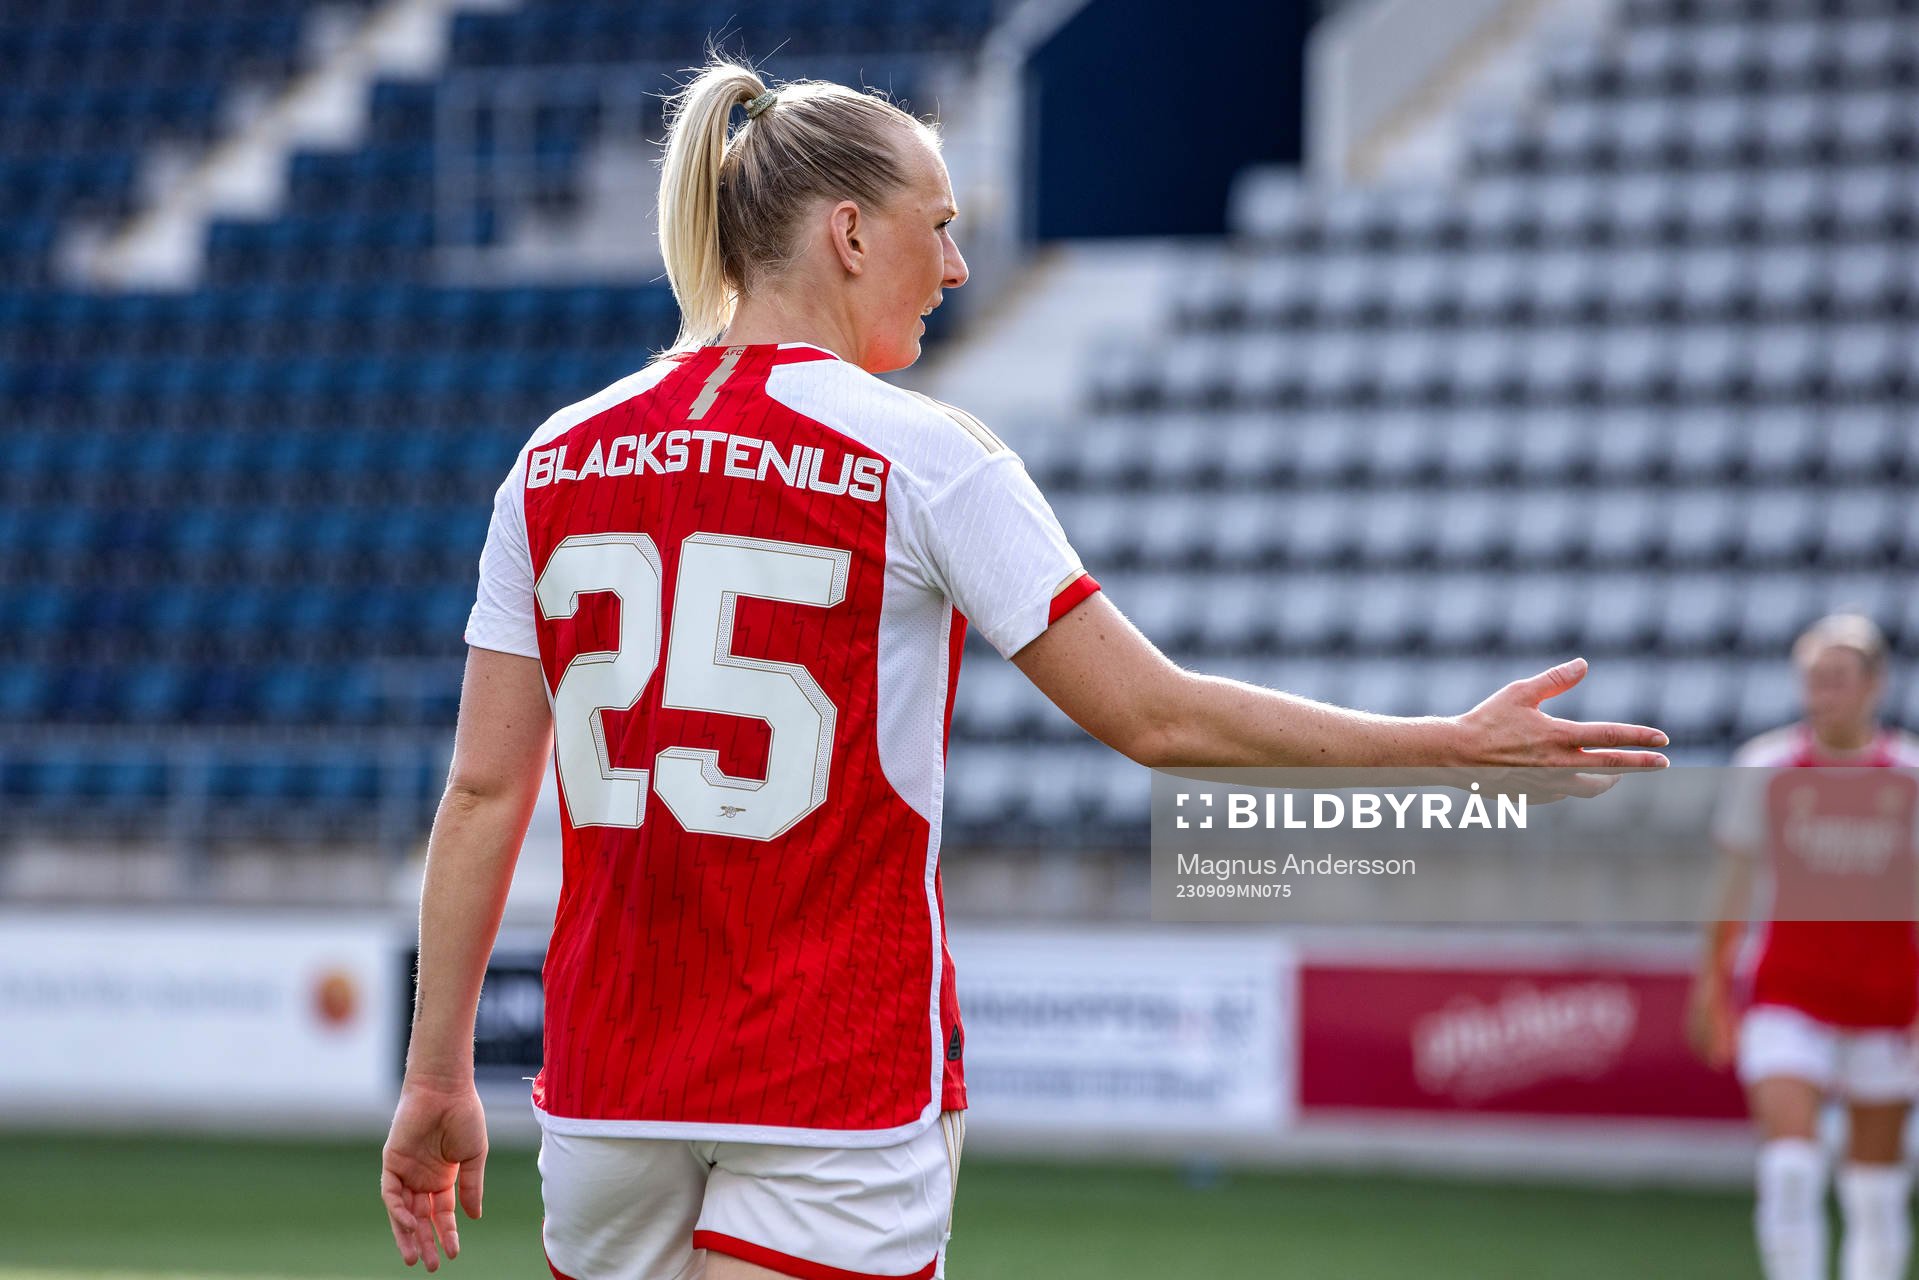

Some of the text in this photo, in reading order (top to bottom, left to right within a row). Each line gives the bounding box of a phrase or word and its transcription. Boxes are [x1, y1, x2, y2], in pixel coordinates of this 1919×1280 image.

[724, 349, 743, 357] AFC
[527, 430, 884, 502] BLACKSTENIUS
[534, 532, 851, 841] 25
